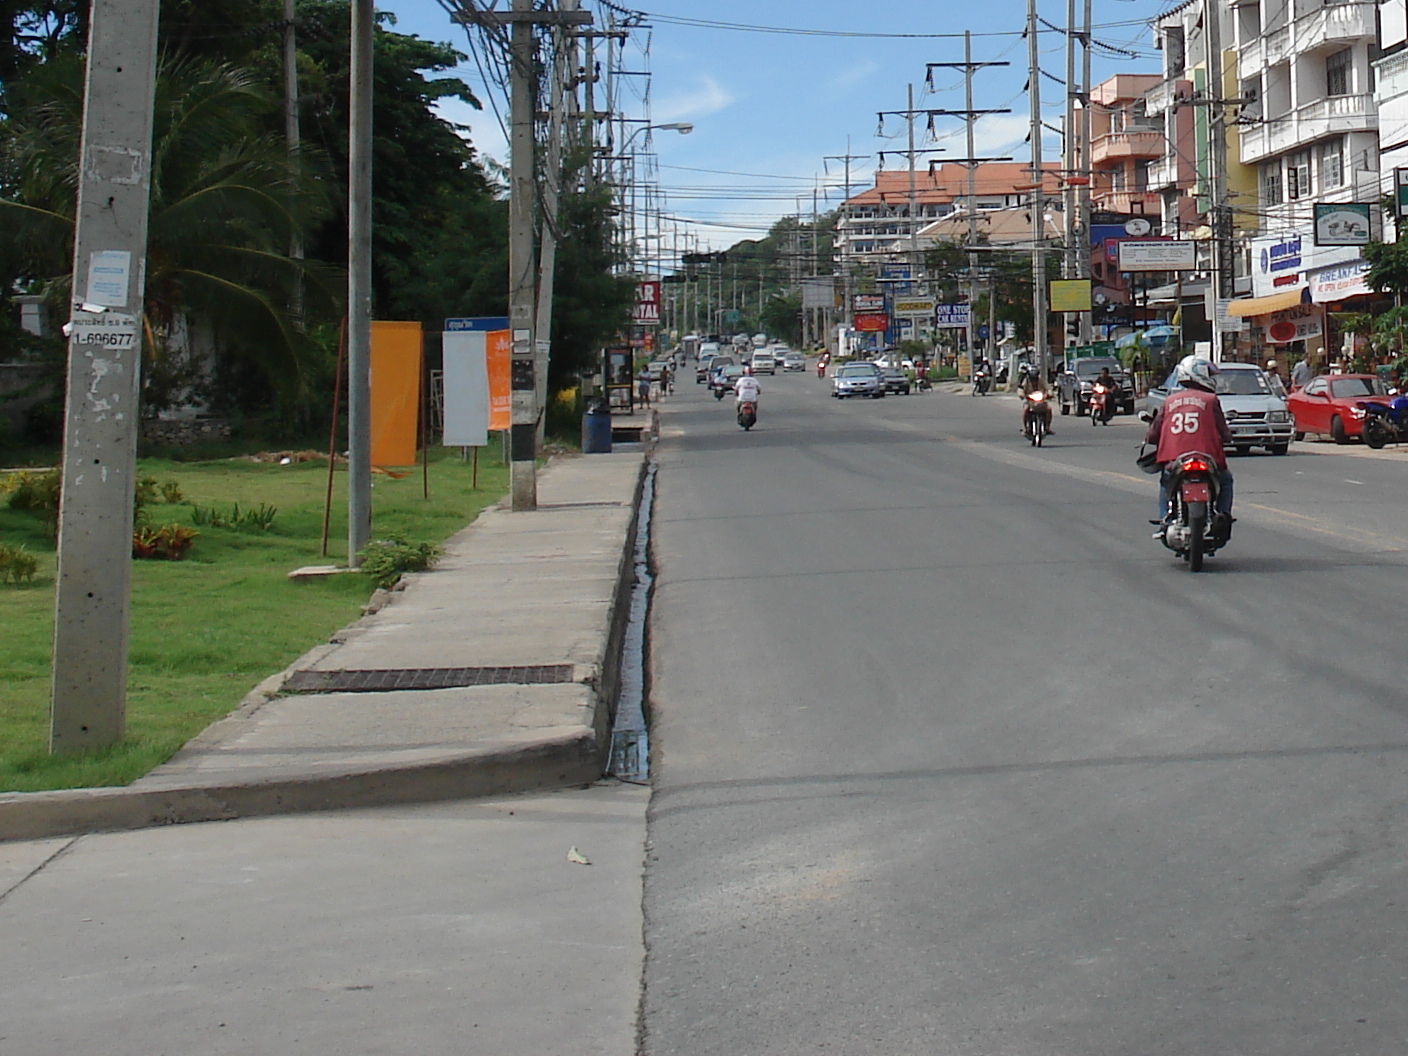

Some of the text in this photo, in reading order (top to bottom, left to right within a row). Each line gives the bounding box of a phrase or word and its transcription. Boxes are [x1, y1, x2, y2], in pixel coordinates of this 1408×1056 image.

[634, 285, 654, 302] AR
[630, 305, 658, 319] NTAL
[937, 305, 951, 315] ONE
[1171, 411, 1199, 434] 35
